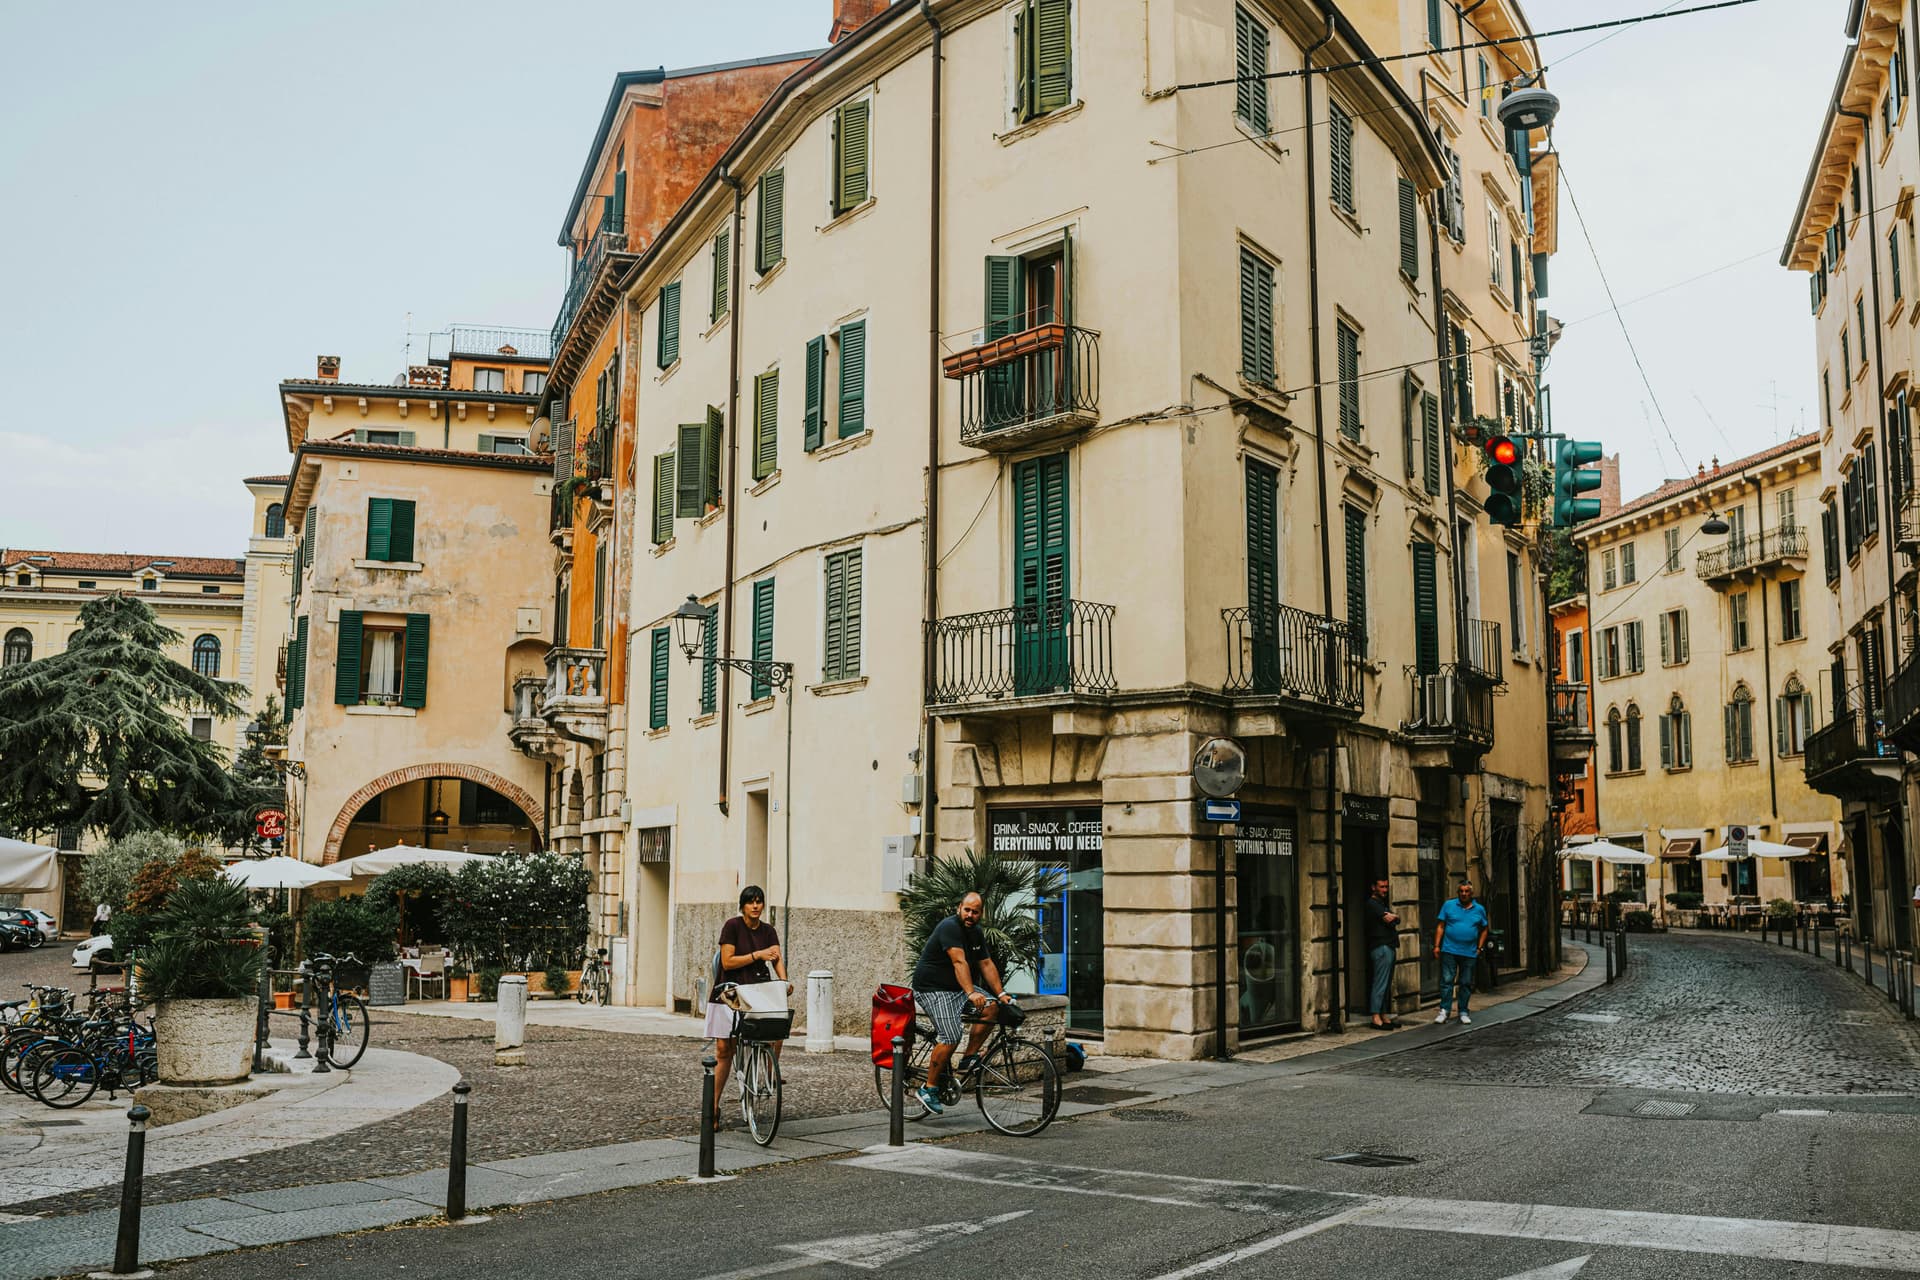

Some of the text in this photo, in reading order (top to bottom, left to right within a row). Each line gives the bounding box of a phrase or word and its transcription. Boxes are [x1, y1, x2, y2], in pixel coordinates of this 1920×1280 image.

[993, 823, 1020, 835] DRINK
[1028, 822, 1059, 834] SNACK
[1068, 821, 1102, 834] COFFEE
[1249, 826, 1269, 838] SNACK
[1272, 828, 1292, 840] COFFEE
[993, 835, 1103, 851] EVERYTHING YOU NEED
[1235, 840, 1292, 856] ERYTHING YOU NEED
